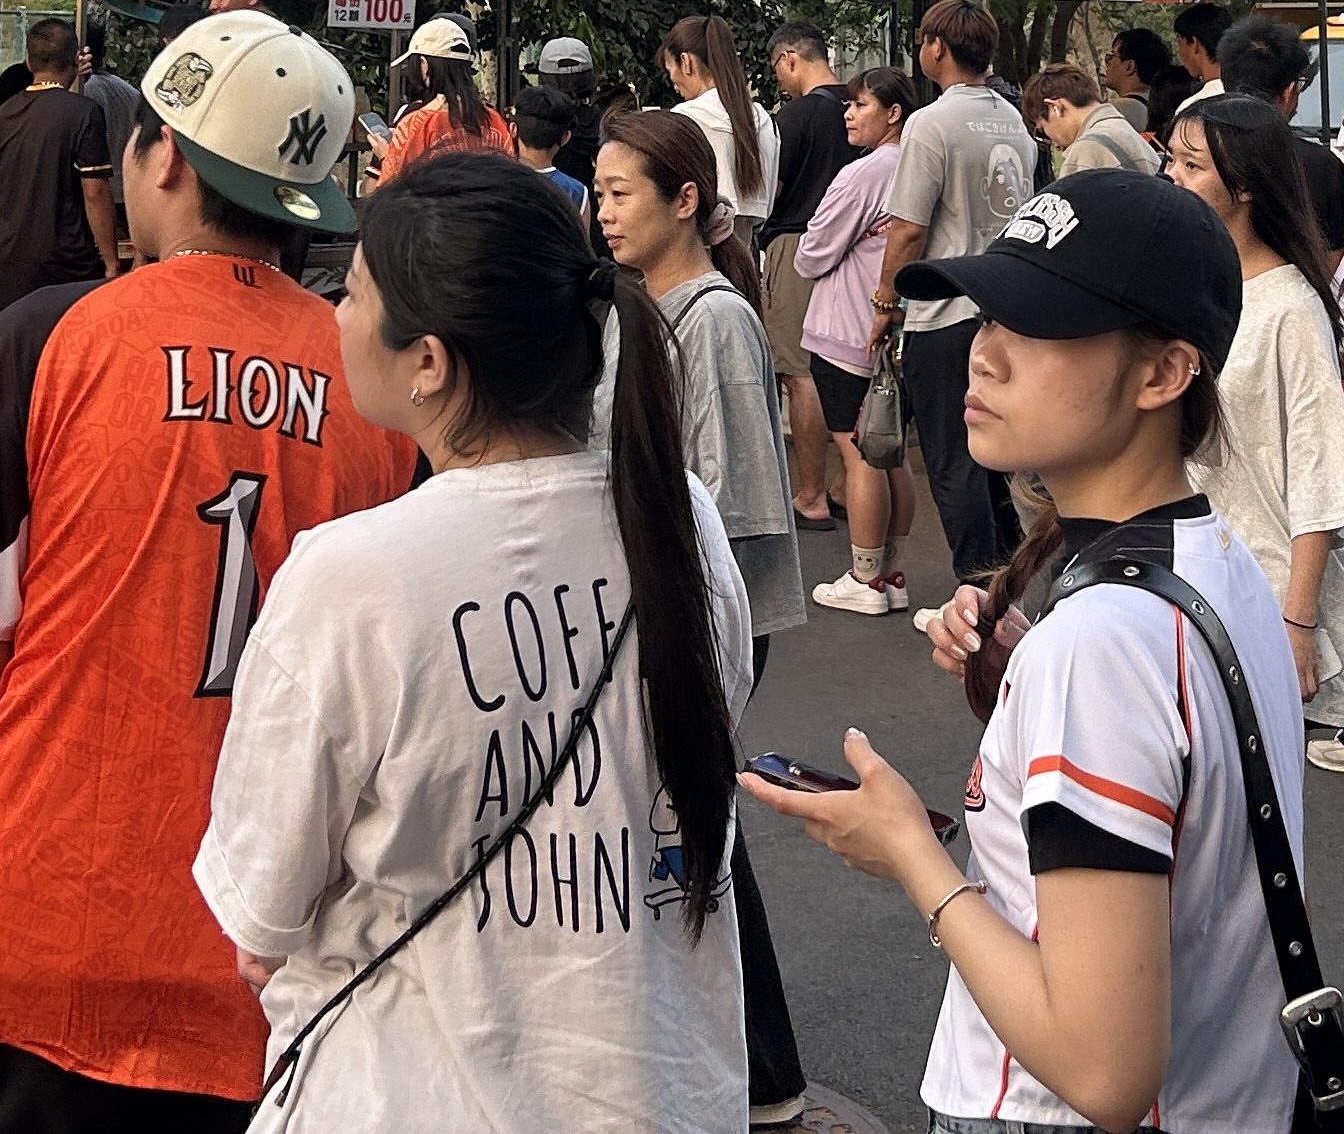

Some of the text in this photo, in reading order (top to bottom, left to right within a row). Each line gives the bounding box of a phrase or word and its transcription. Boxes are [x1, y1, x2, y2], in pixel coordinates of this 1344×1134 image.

[277, 107, 329, 166] NY
[161, 345, 333, 446] LION
[193, 470, 269, 699] 1
[473, 706, 603, 823] AND
[471, 824, 632, 934] JOHN
